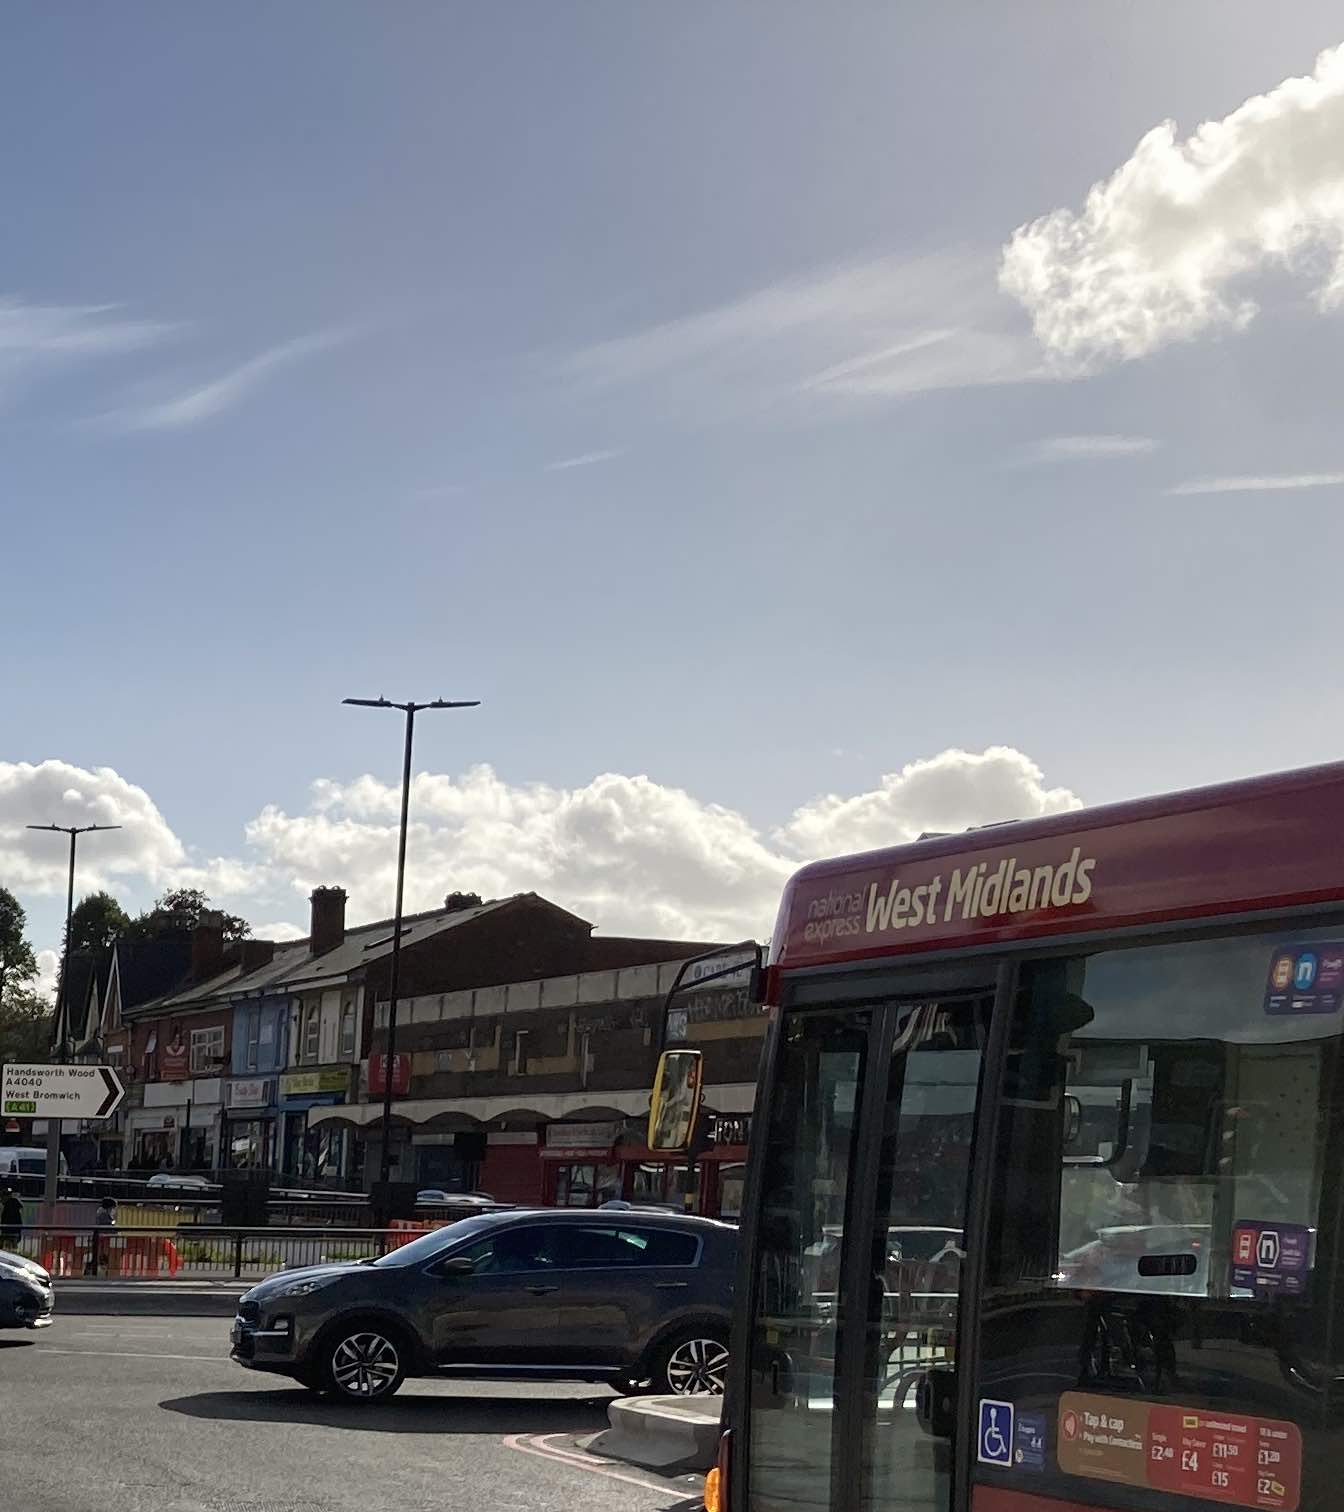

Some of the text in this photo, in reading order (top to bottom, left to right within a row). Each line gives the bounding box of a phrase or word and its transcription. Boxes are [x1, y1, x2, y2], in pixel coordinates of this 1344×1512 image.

[865, 847, 1096, 933] West Midlands
[808, 885, 866, 915] national
[804, 915, 861, 947] express
[6, 1067, 96, 1078] Handsworth Wood
[5, 1077, 43, 1087] A4040
[5, 1090, 81, 1100] West Bromwich
[1084, 1411, 1099, 1429] Tap
[1100, 1414, 1108, 1428] &
[1181, 1450, 1199, 1472] £4
[1211, 1470, 1230, 1487] £15
[1257, 1478, 1271, 1495] £2
